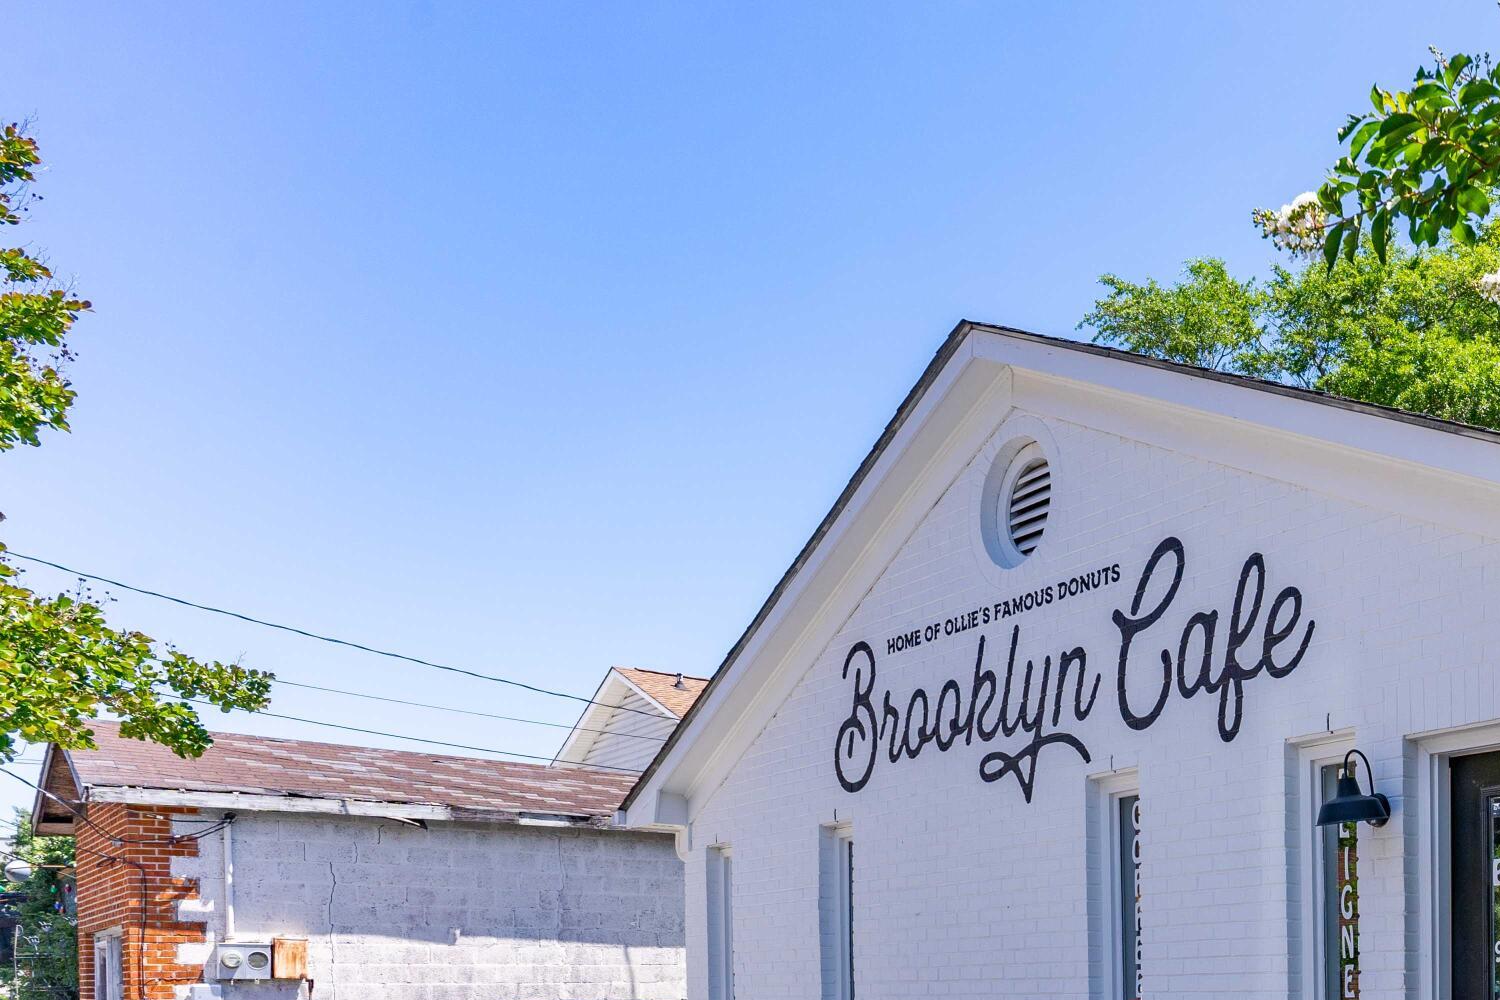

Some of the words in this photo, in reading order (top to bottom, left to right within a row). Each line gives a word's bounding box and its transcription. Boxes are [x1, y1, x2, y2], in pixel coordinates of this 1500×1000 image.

[834, 624, 1102, 804] Brooklyn
[1111, 536, 1316, 743] Cafe
[886, 629, 922, 655] HOME
[925, 622, 941, 643] OF
[944, 606, 991, 636] OLLIE'S
[994, 586, 1054, 621] FAMOUS
[1058, 563, 1121, 601] DONUTS
